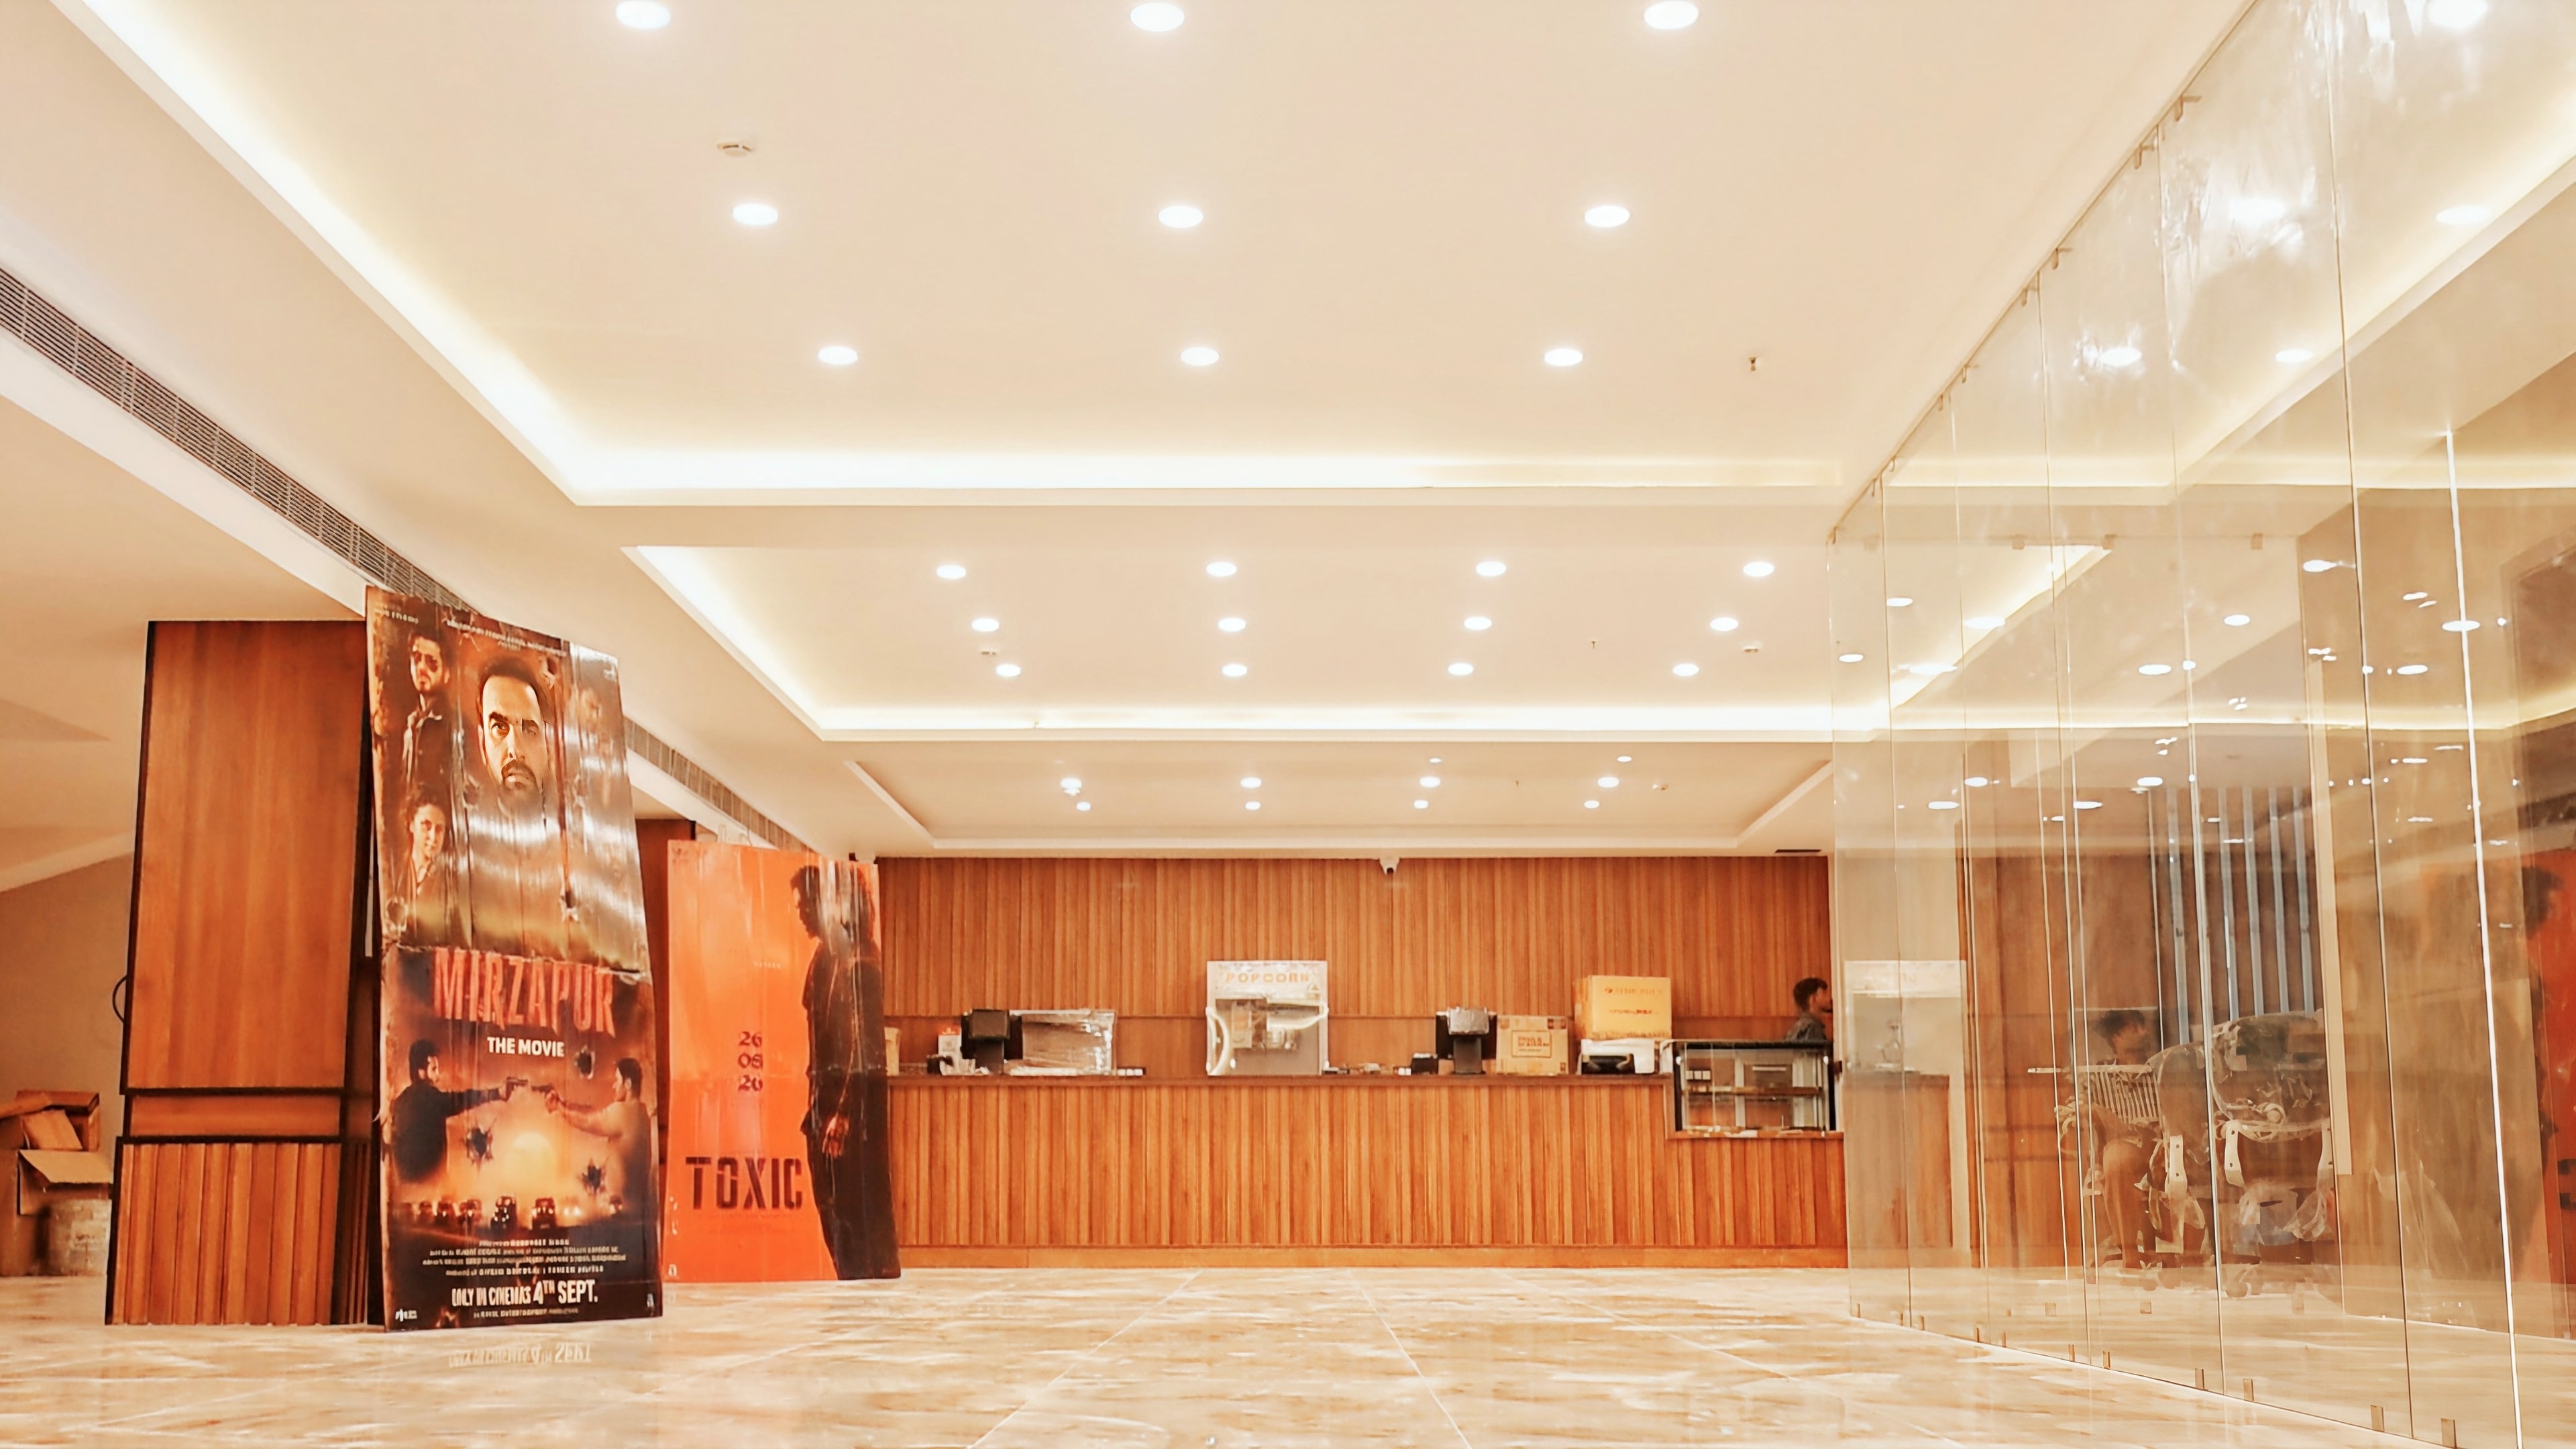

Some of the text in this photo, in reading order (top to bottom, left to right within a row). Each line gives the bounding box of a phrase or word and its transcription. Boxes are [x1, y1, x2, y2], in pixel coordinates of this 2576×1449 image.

[1224, 972, 1310, 983] POPCORN
[433, 947, 616, 1038] MIRZAPUR
[487, 1036, 565, 1058] THE MOVIE
[685, 1157, 803, 1210] TOXIC
[557, 1279, 598, 1304] SEPT.
